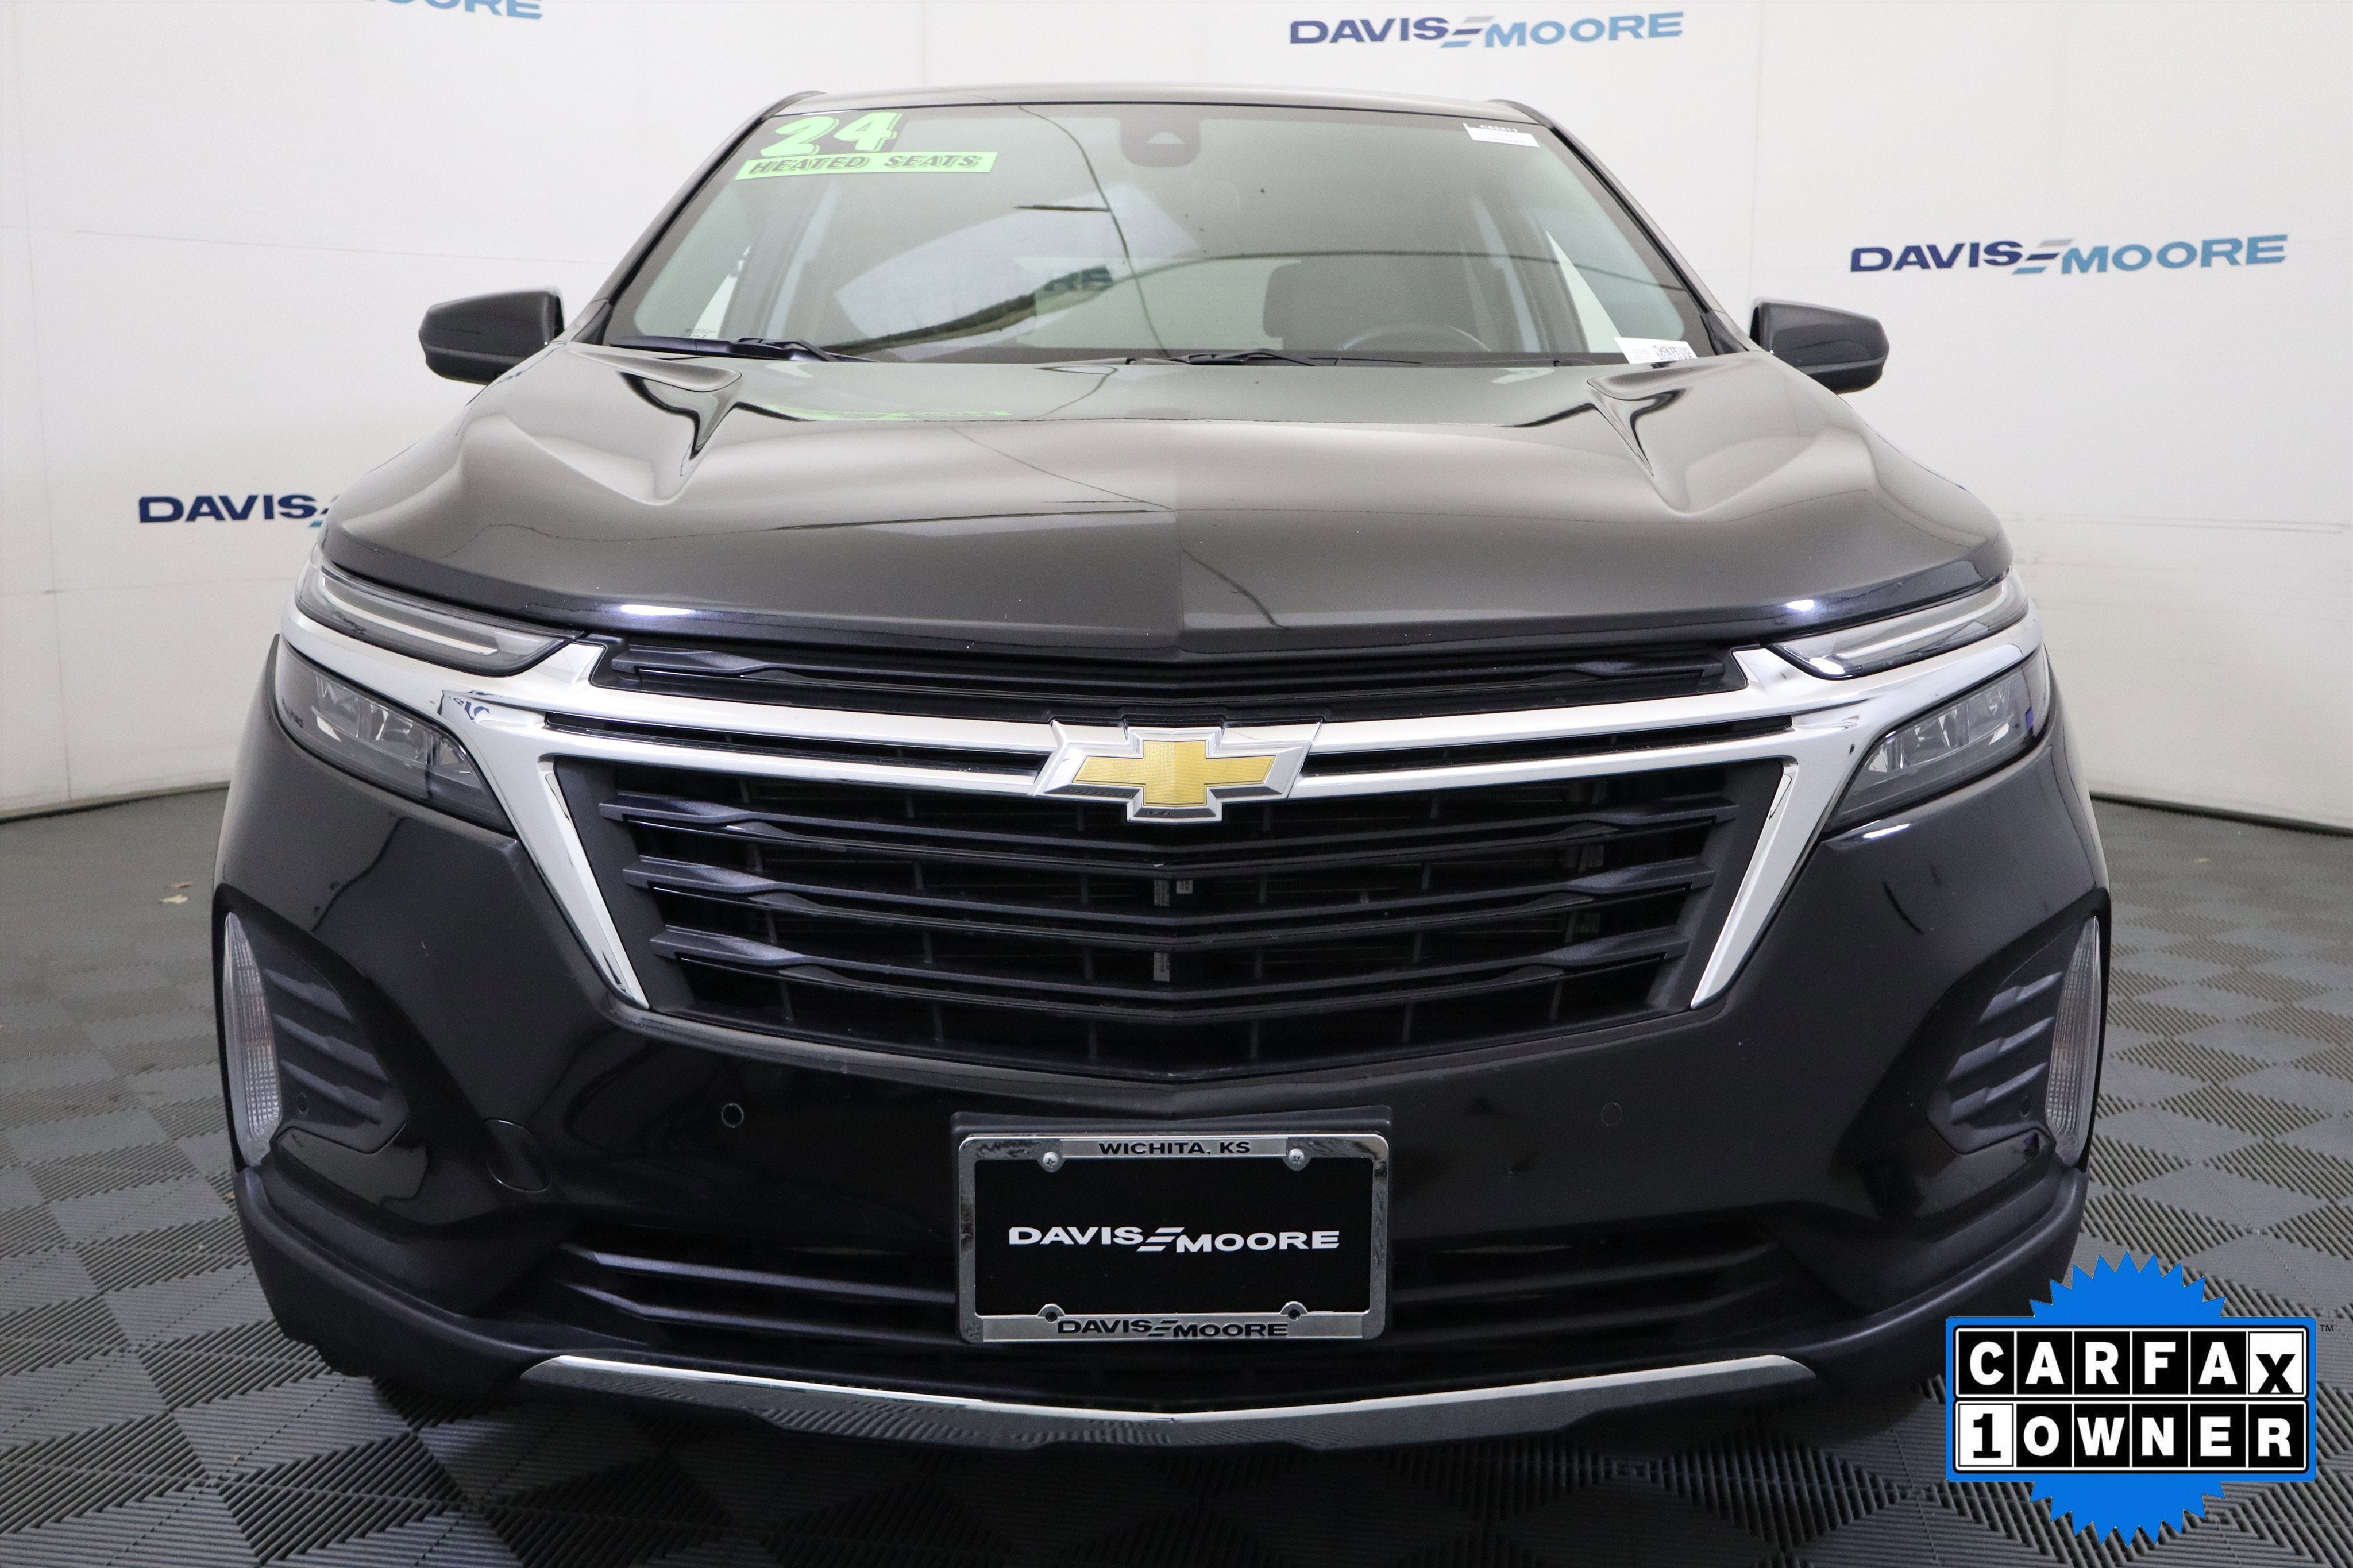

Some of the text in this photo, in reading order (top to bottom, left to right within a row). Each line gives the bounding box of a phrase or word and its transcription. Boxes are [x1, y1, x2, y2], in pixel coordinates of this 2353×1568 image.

[1290, 11, 1684, 48] DAVIS MOORE
[760, 112, 904, 157] 24
[749, 155, 983, 175] HEATED SEATS
[1850, 234, 2289, 275] DAVIS MOORE
[138, 494, 318, 523] DAVIS
[1098, 1141, 1251, 1156] WICHITA, KS
[1009, 1226, 1340, 1253] DAVIS MOORE
[1058, 1320, 1289, 1338] DAVIS MOORE
